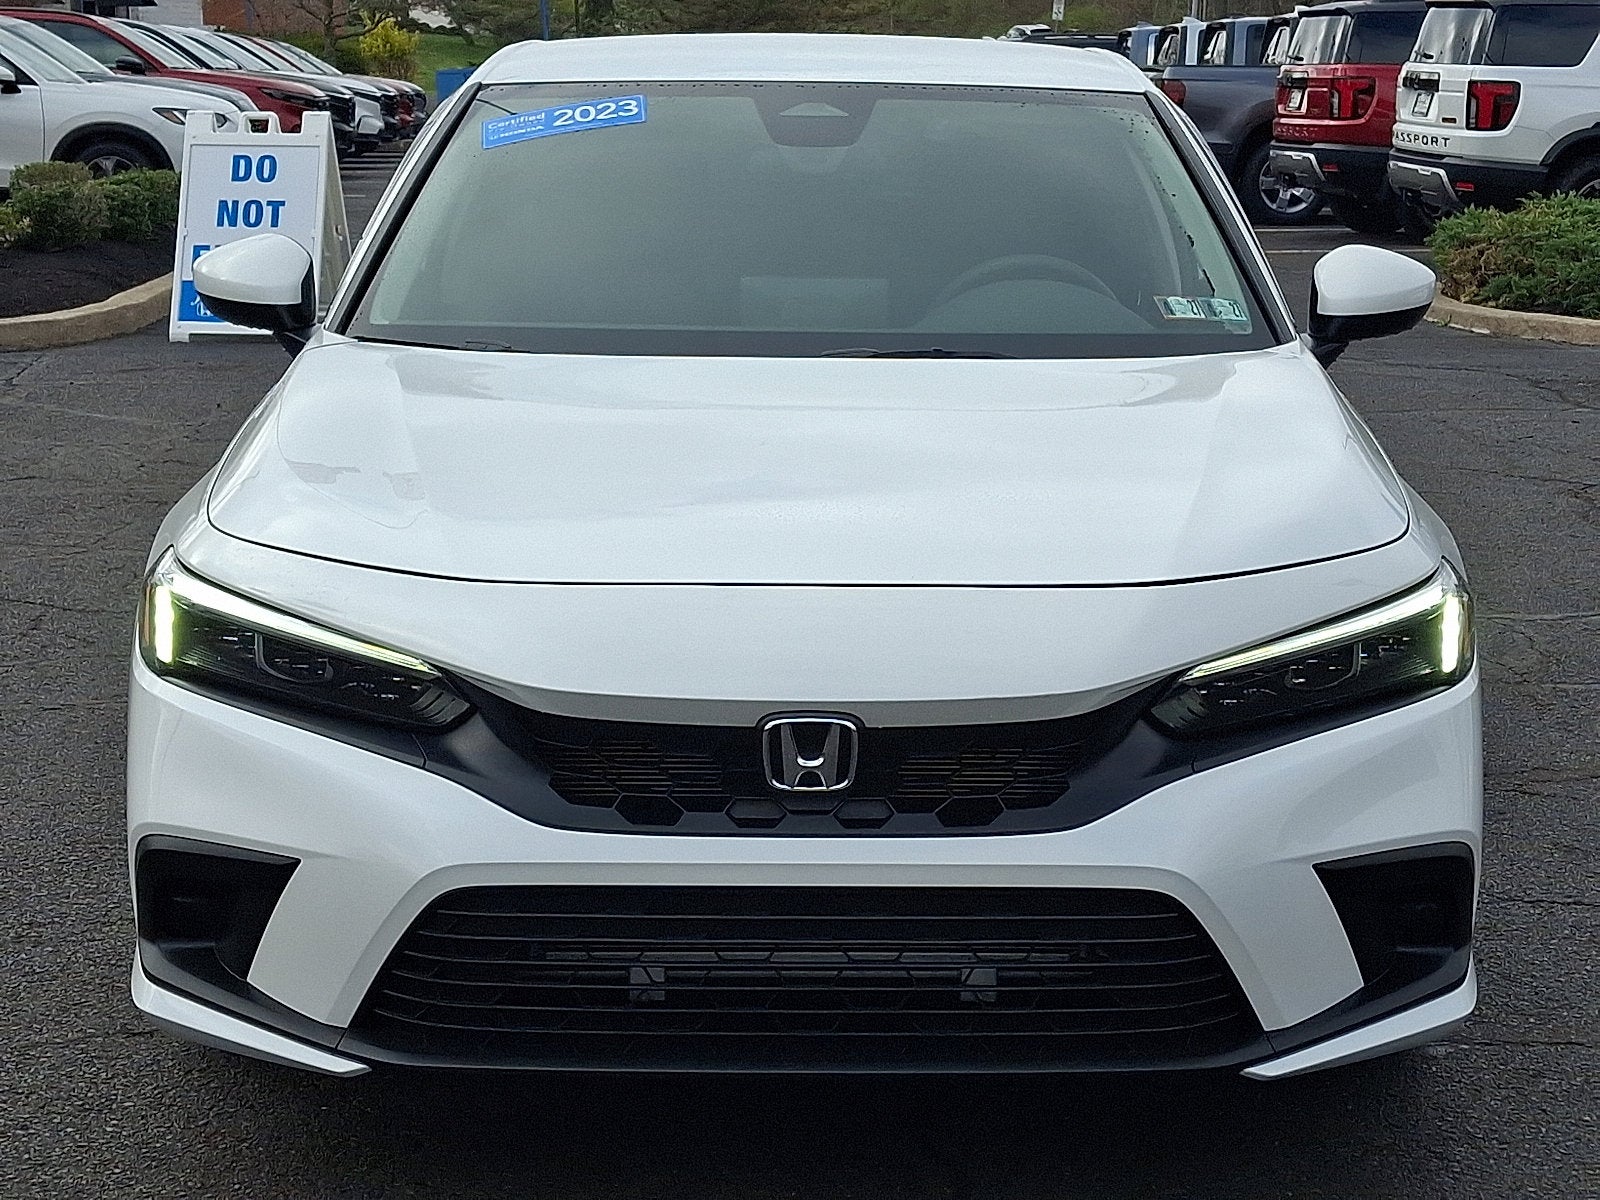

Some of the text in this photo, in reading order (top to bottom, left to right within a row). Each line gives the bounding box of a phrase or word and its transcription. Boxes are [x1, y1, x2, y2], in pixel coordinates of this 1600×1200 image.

[488, 112, 545, 129] Certified
[553, 99, 639, 127] 2023
[231, 154, 278, 183] DO
[216, 199, 286, 228] NOT
